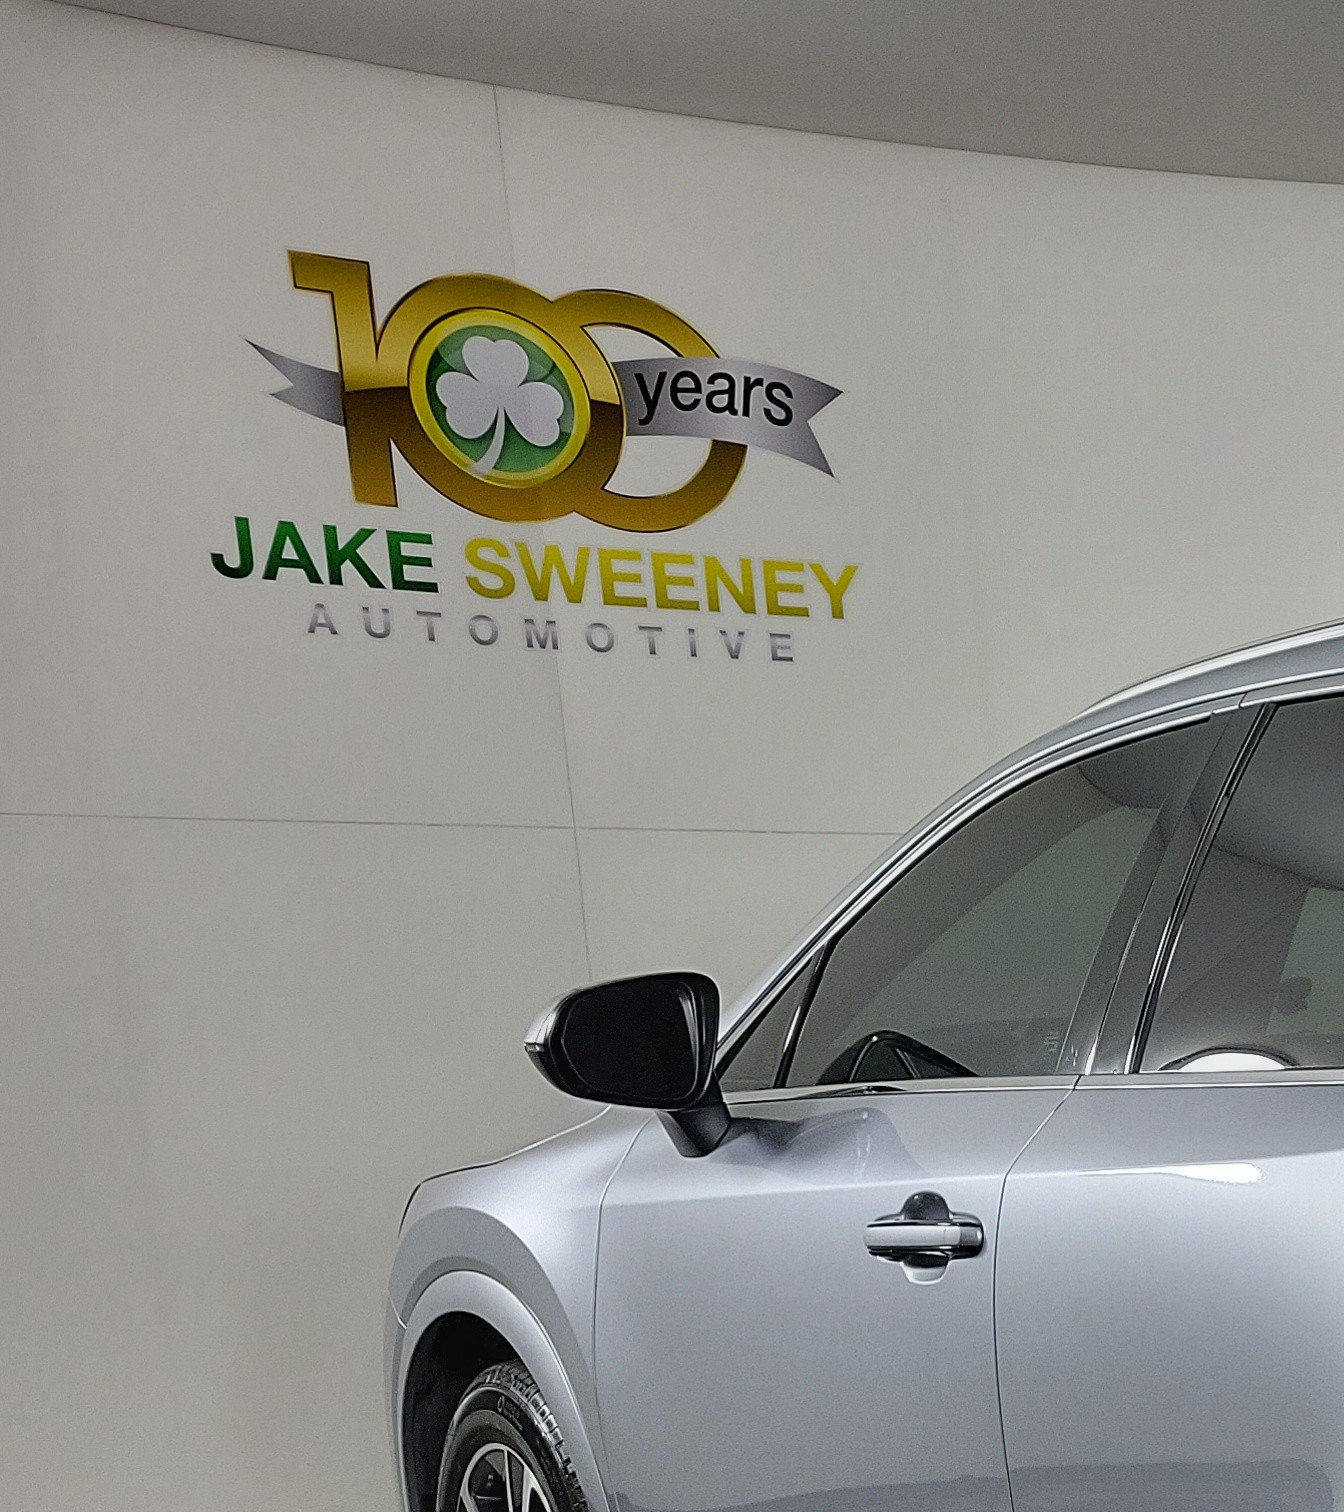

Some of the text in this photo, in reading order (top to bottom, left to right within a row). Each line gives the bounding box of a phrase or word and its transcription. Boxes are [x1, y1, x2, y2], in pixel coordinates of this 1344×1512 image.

[287, 249, 749, 534] 100
[633, 369, 795, 427] years
[209, 515, 860, 620] JAKE SWEENEY
[306, 602, 796, 664] AUTOMOTIVE
